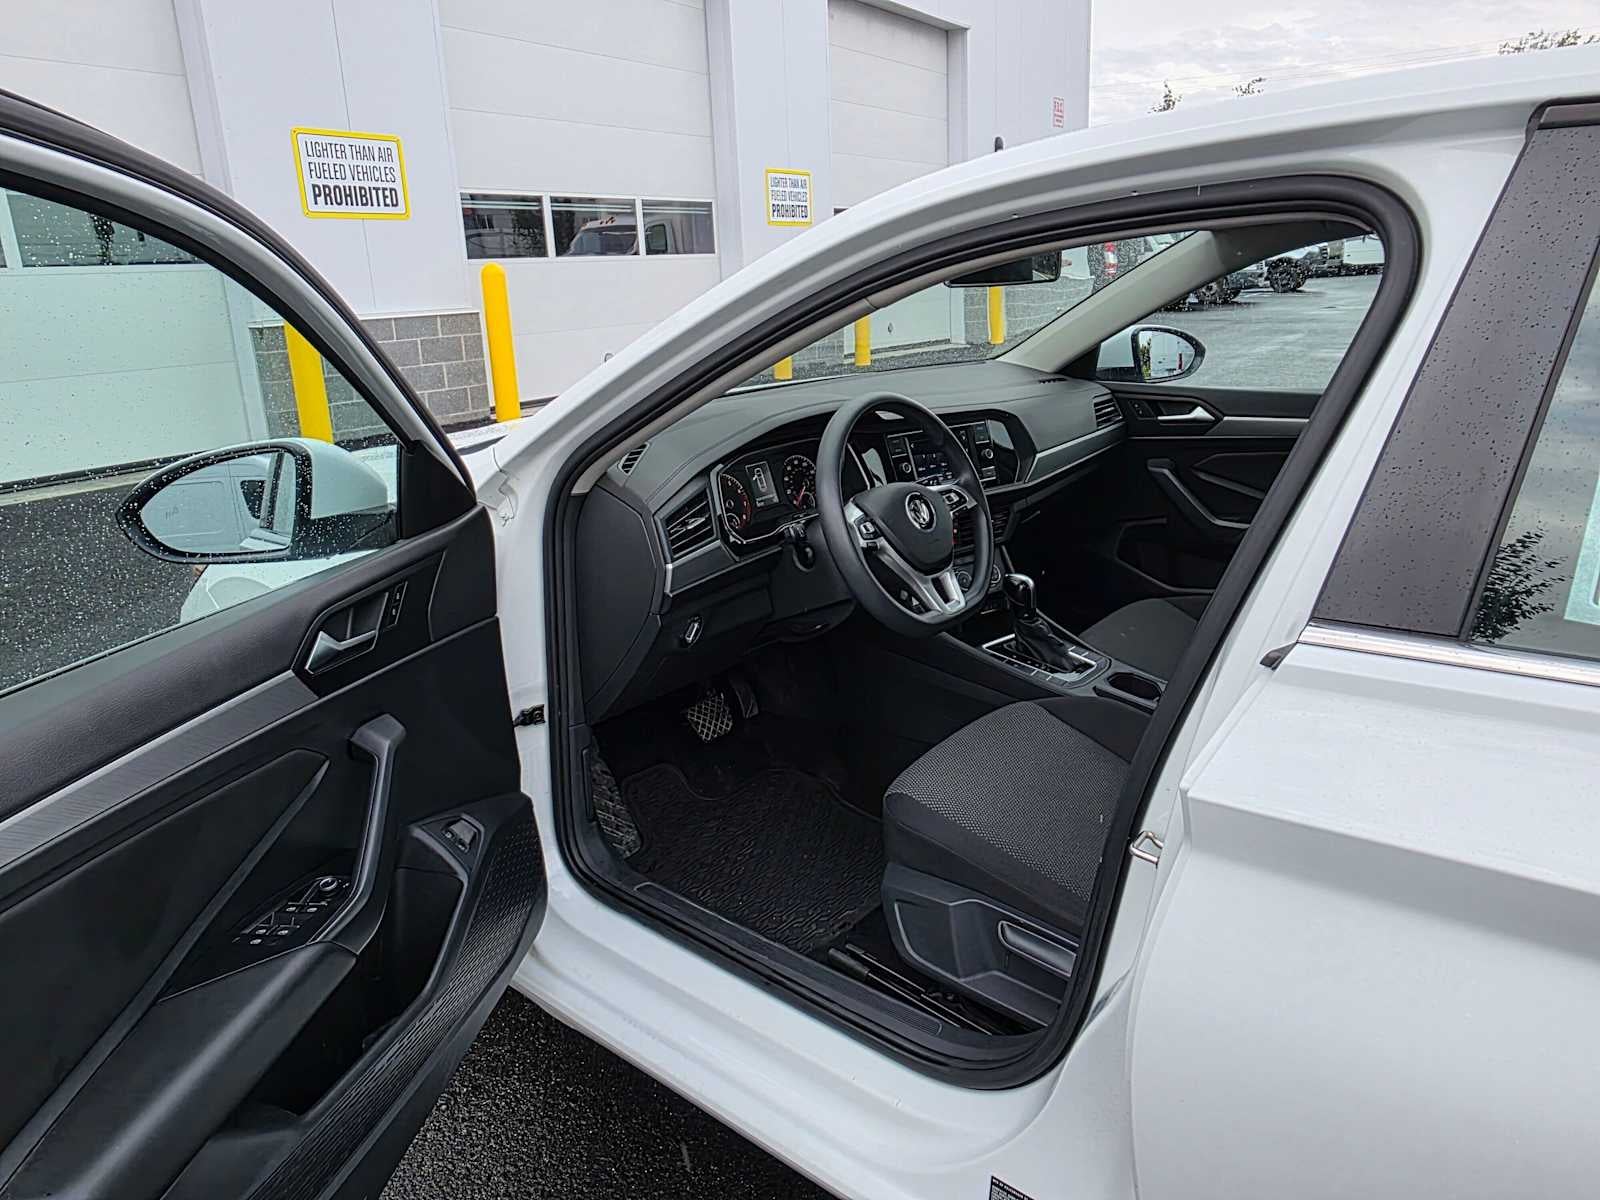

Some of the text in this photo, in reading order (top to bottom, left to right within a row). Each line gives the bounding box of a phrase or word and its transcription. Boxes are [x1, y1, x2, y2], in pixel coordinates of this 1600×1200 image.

[305, 140, 394, 163] LIGHTER THAN AIR
[308, 161, 396, 183] FUELED VEHICLES
[771, 176, 788, 188] LIGHTER
[788, 177, 800, 188] THAN
[311, 183, 399, 207] PROHIBITED
[772, 203, 808, 218] PROHIBITED
